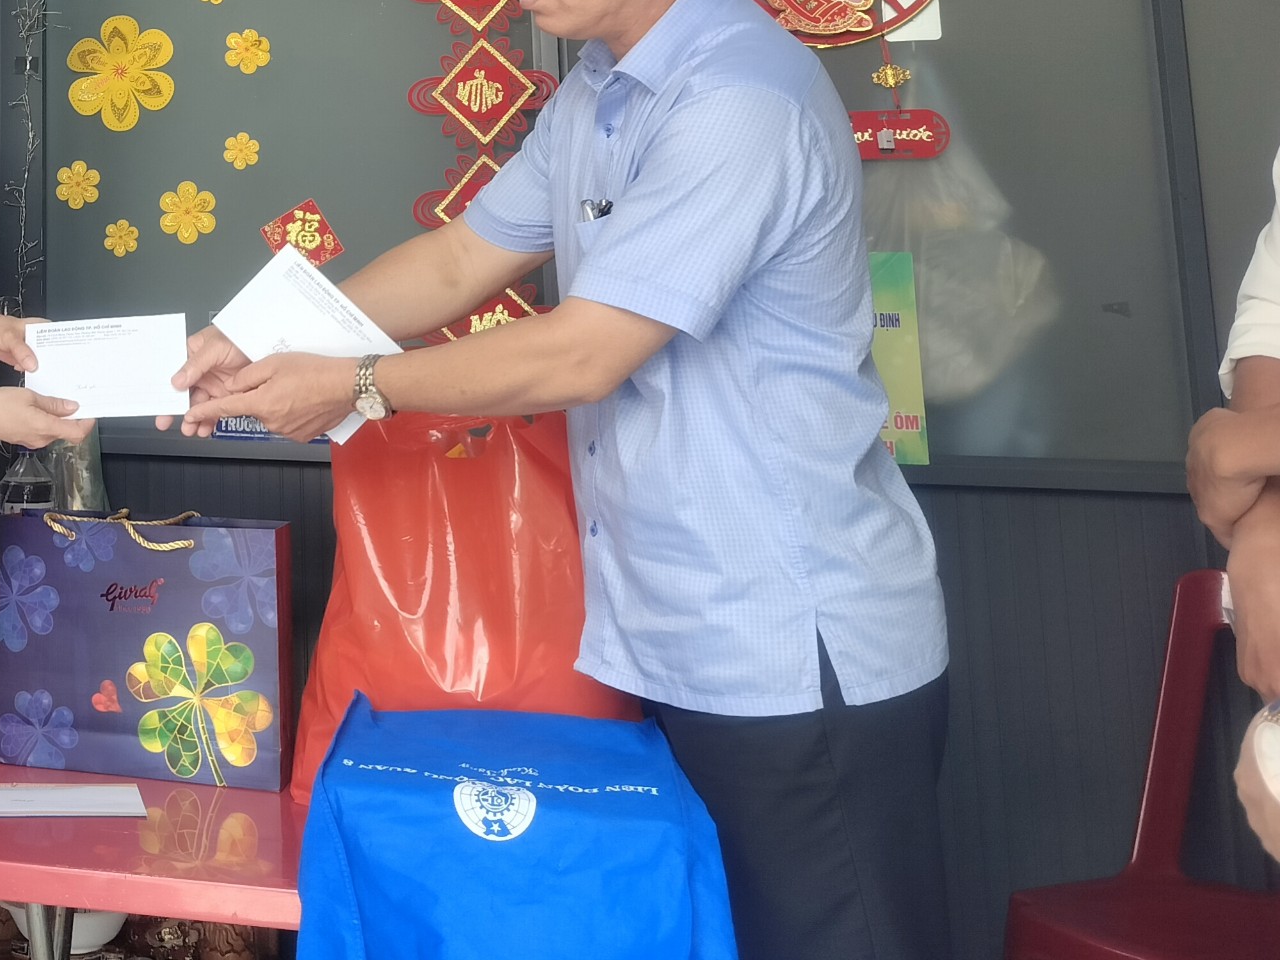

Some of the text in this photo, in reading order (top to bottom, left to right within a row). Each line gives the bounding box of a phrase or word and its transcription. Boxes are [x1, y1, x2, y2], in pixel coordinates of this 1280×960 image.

[456, 69, 504, 113] MỪNG
[883, 125, 934, 142] ước
[879, 312, 901, 331] ĐỊNH
[893, 411, 920, 430] ÔM
